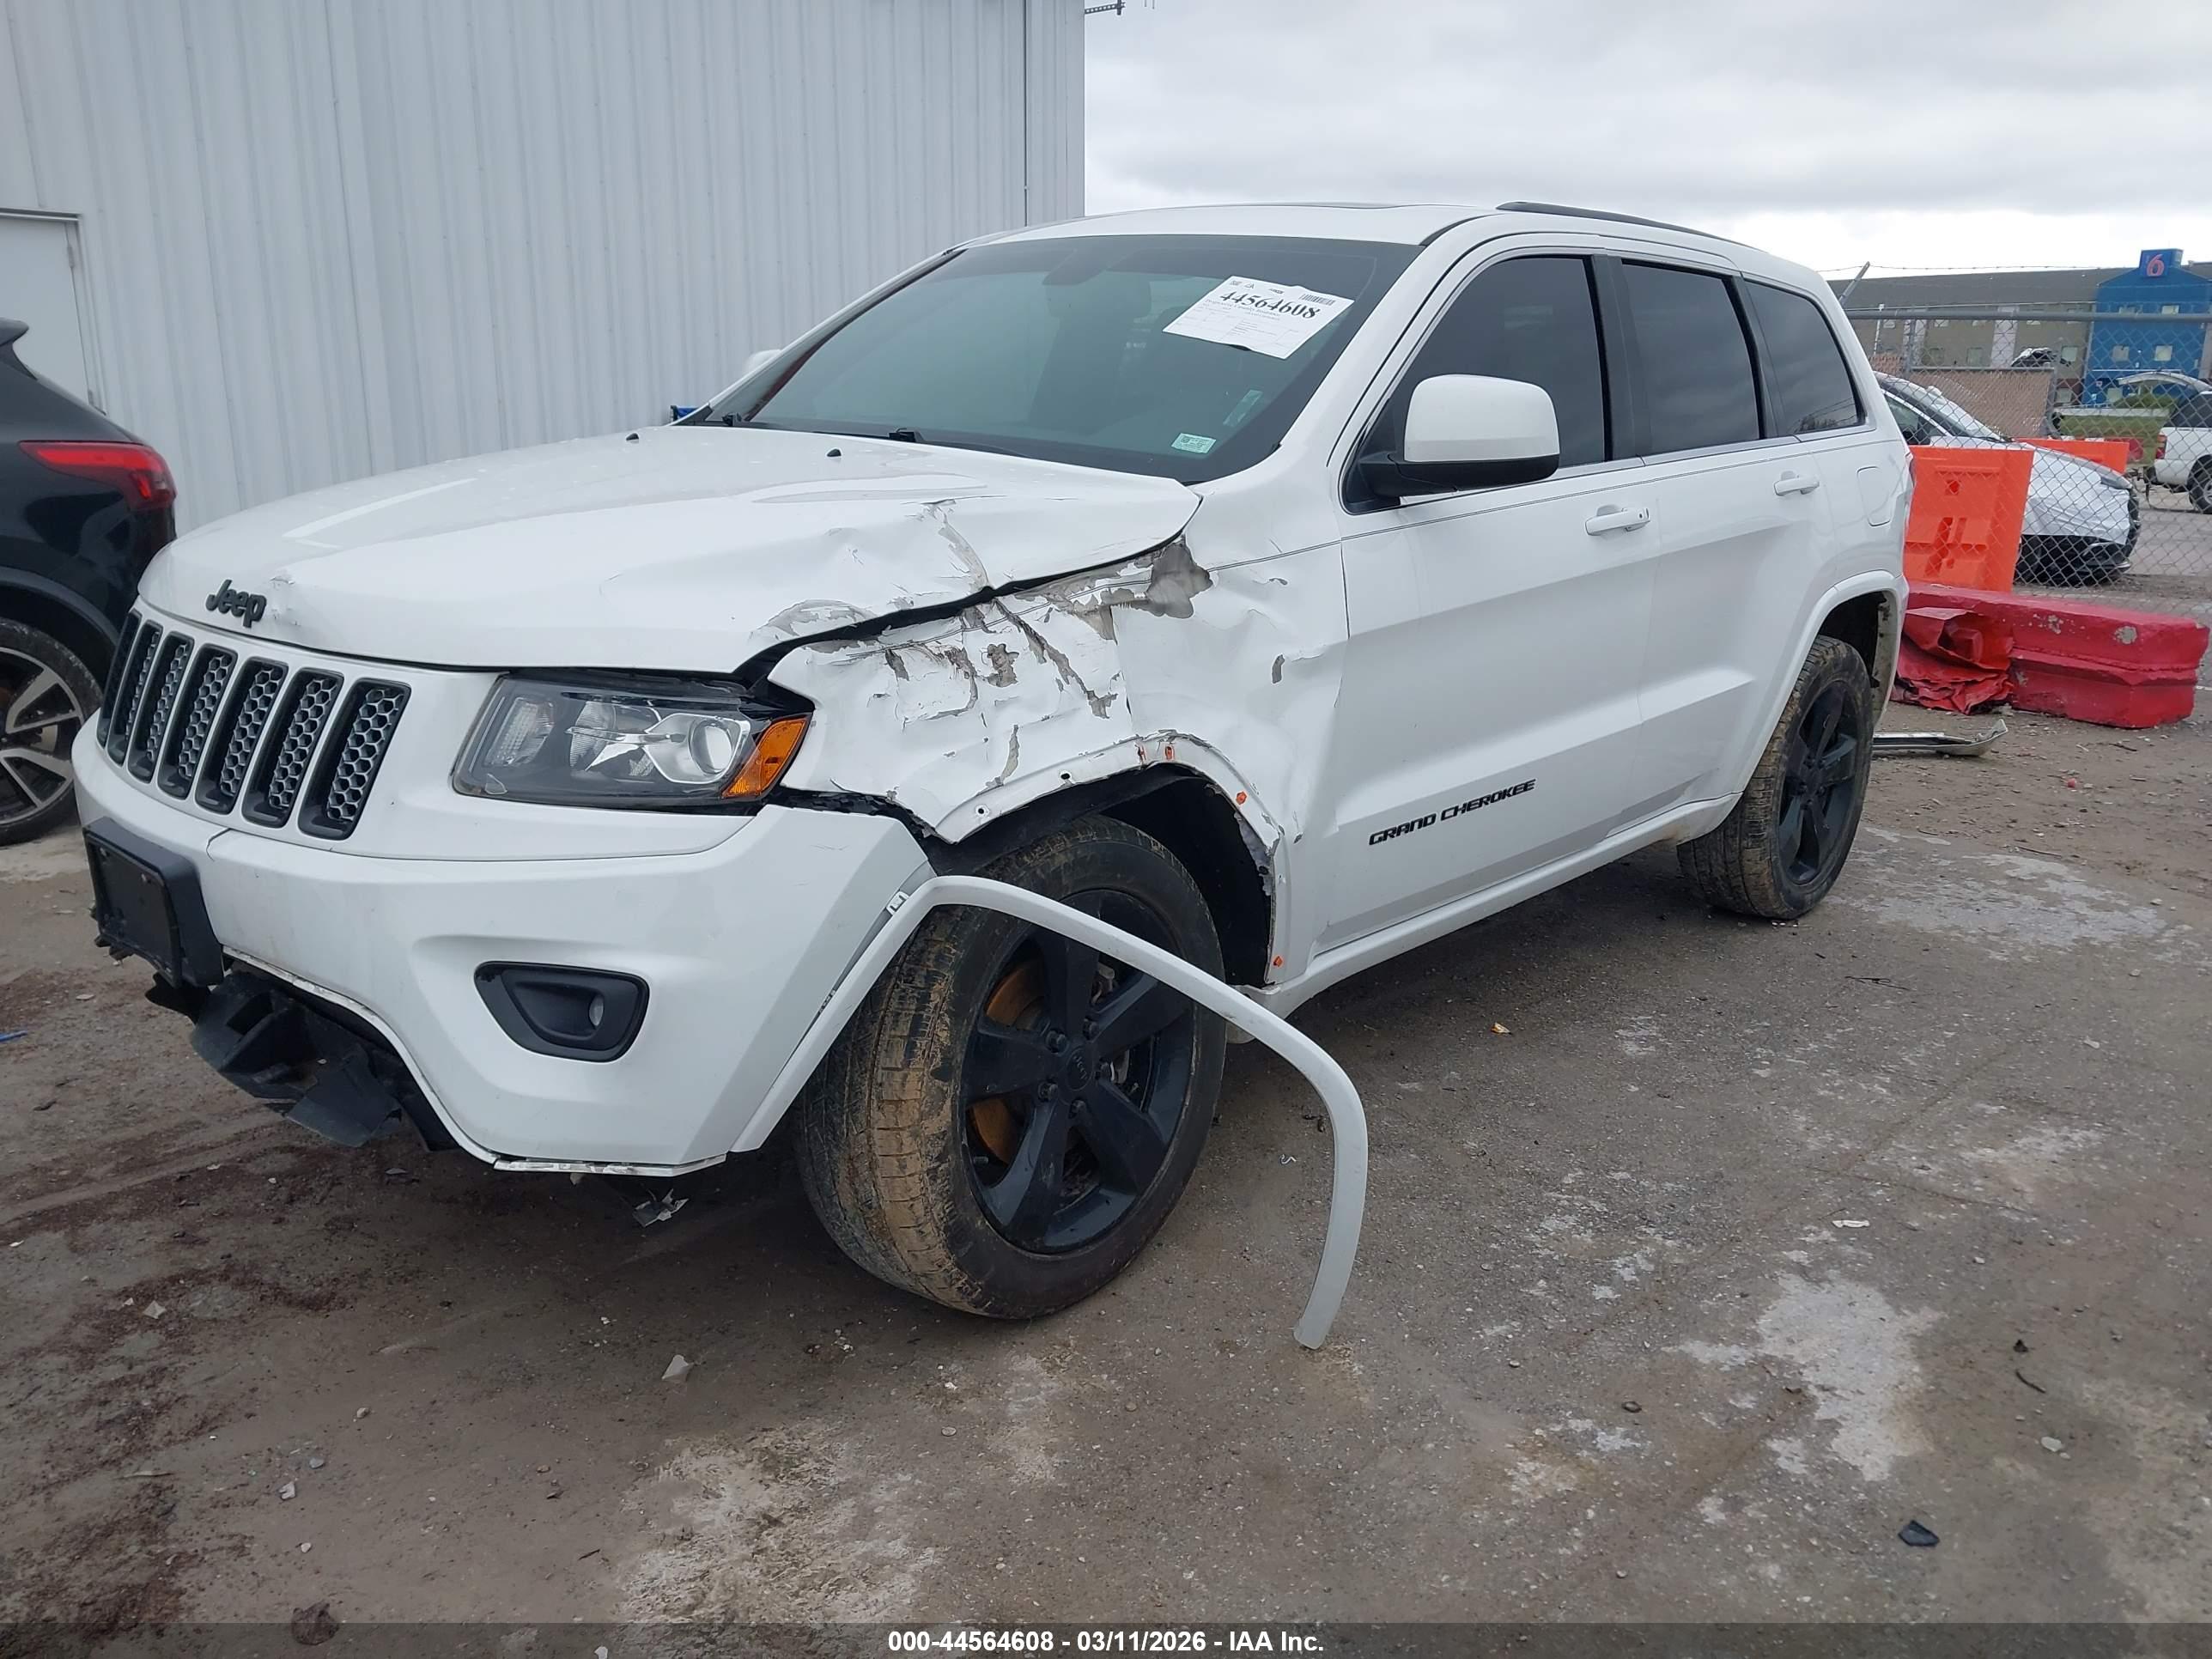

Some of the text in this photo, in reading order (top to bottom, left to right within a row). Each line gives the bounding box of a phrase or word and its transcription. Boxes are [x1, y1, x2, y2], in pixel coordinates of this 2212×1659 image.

[2147, 253, 2165, 276] 6
[1219, 291, 1321, 319] 44564608
[205, 579, 267, 629] Jeep
[1369, 779, 1536, 845] GRAND CHEROKEE
